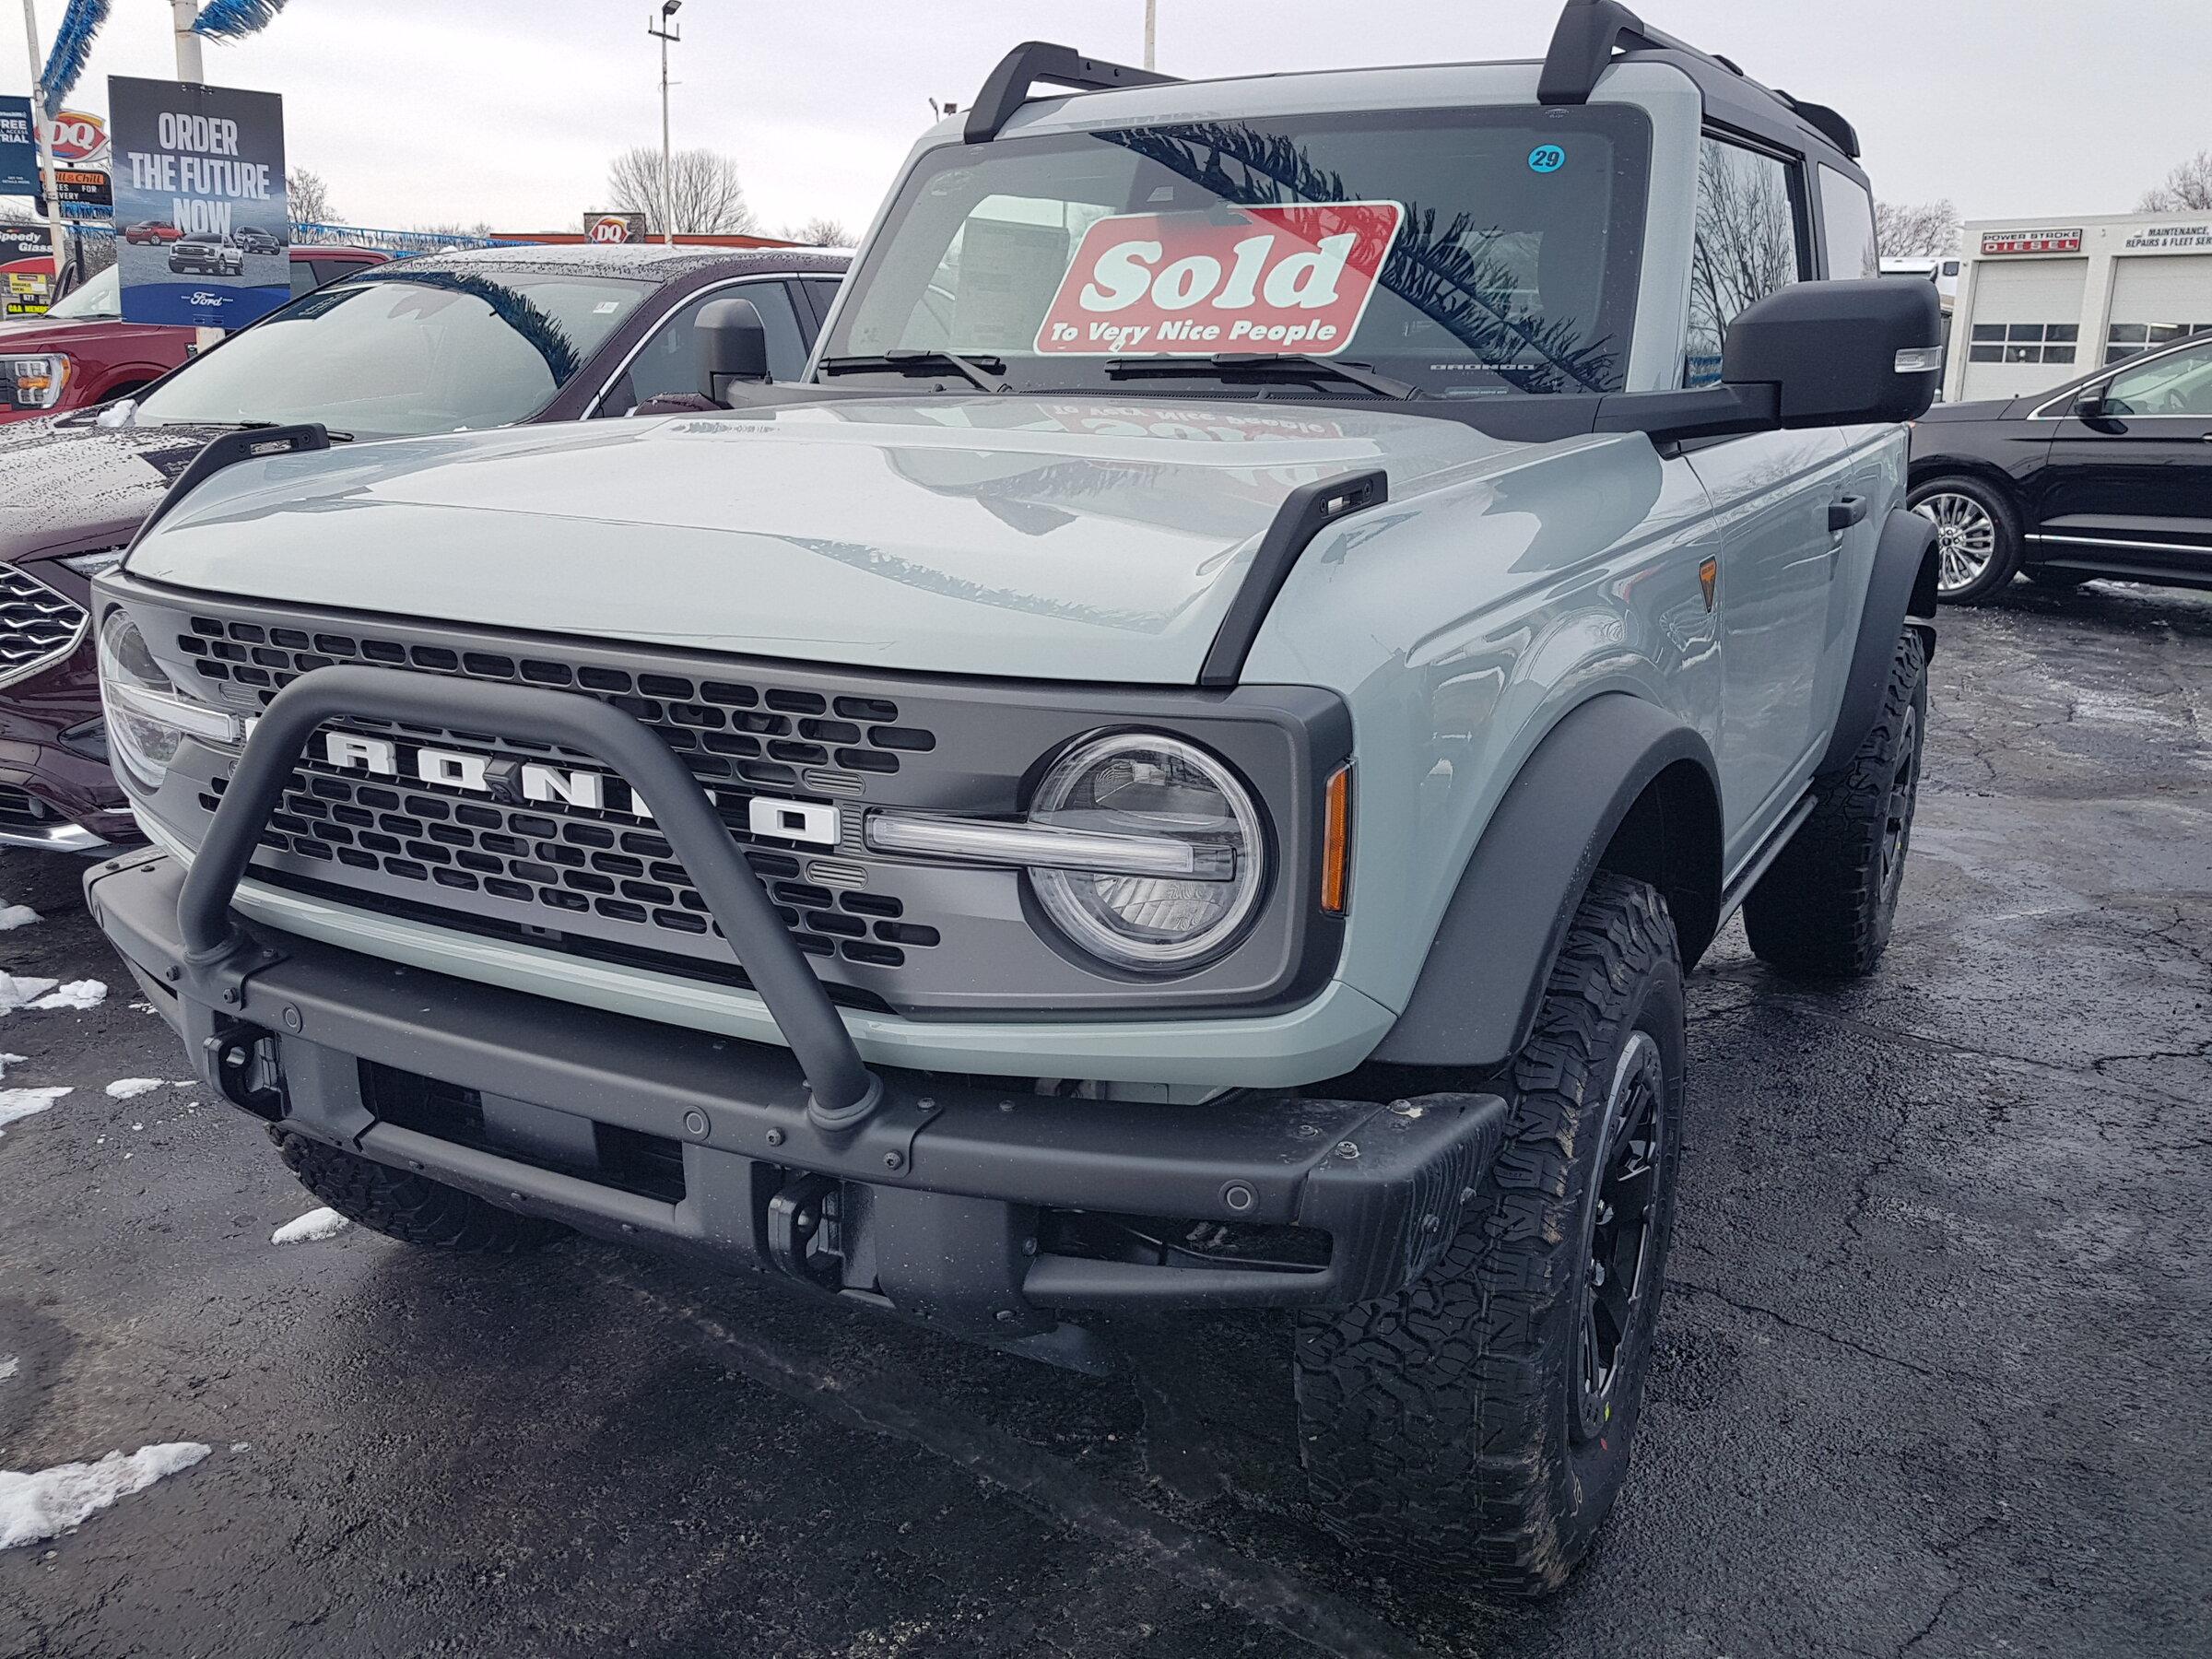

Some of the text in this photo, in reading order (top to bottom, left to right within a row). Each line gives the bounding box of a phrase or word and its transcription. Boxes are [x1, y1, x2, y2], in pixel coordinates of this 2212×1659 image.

[0, 120, 27, 130] REE
[159, 112, 239, 156] ORDER
[46, 120, 95, 150] DQ
[1532, 150, 1559, 167] 29
[128, 151, 271, 200] THE FUTURE
[172, 197, 232, 237] NOW
[0, 232, 41, 243] peedy
[596, 224, 622, 243] DQ
[2031, 231, 2078, 240] STROKE
[2125, 239, 2159, 248] REPAIRS
[2162, 238, 2168, 246] &
[2170, 237, 2193, 246] FLEET
[1985, 240, 2076, 252] DIESEL
[1079, 232, 1358, 312] Sold
[190, 291, 223, 307] Ford
[1051, 319, 1337, 347] To Very Nice People
